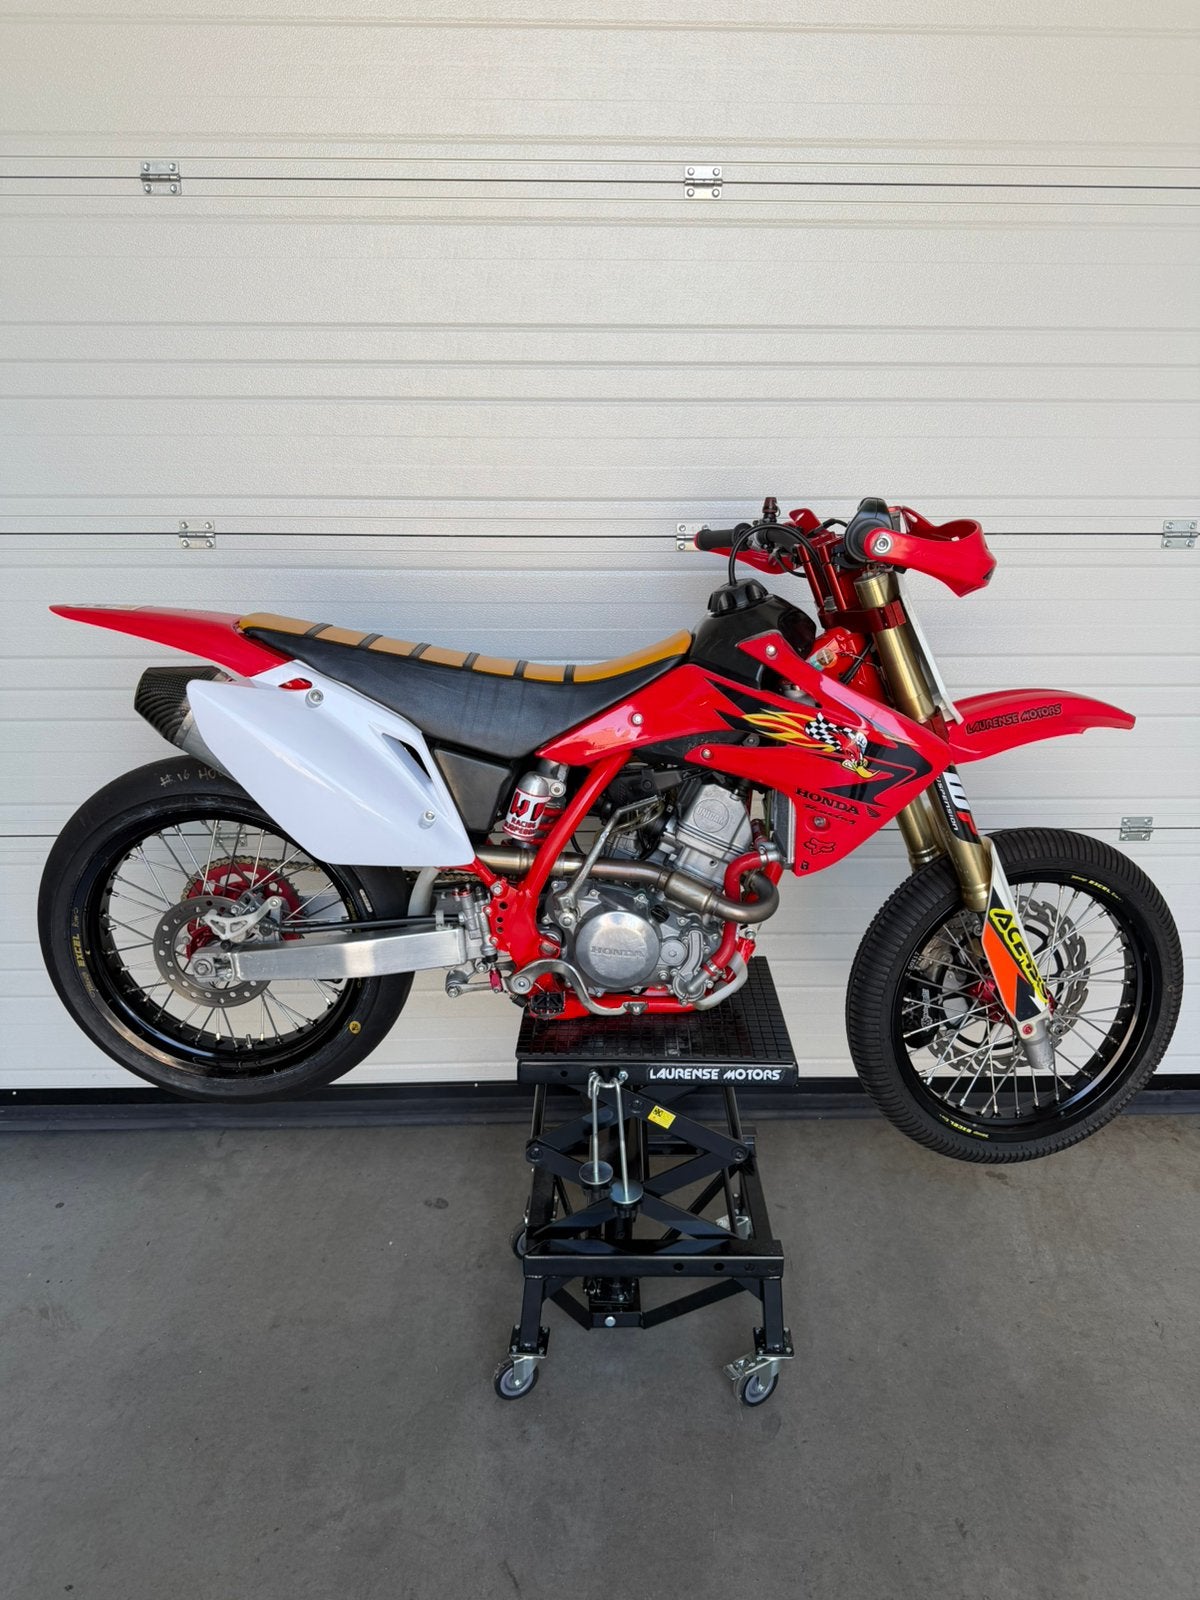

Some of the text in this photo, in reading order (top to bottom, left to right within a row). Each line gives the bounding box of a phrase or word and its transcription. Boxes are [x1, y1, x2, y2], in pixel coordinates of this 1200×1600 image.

[966, 704, 1062, 735] LAURENSE MOTORS
[796, 788, 859, 815] HONDA
[936, 776, 959, 831] USPENSION
[72, 933, 86, 968] EXCEL
[591, 945, 647, 958] HONDA
[649, 1067, 782, 1081] LAURENSE MOTORS
